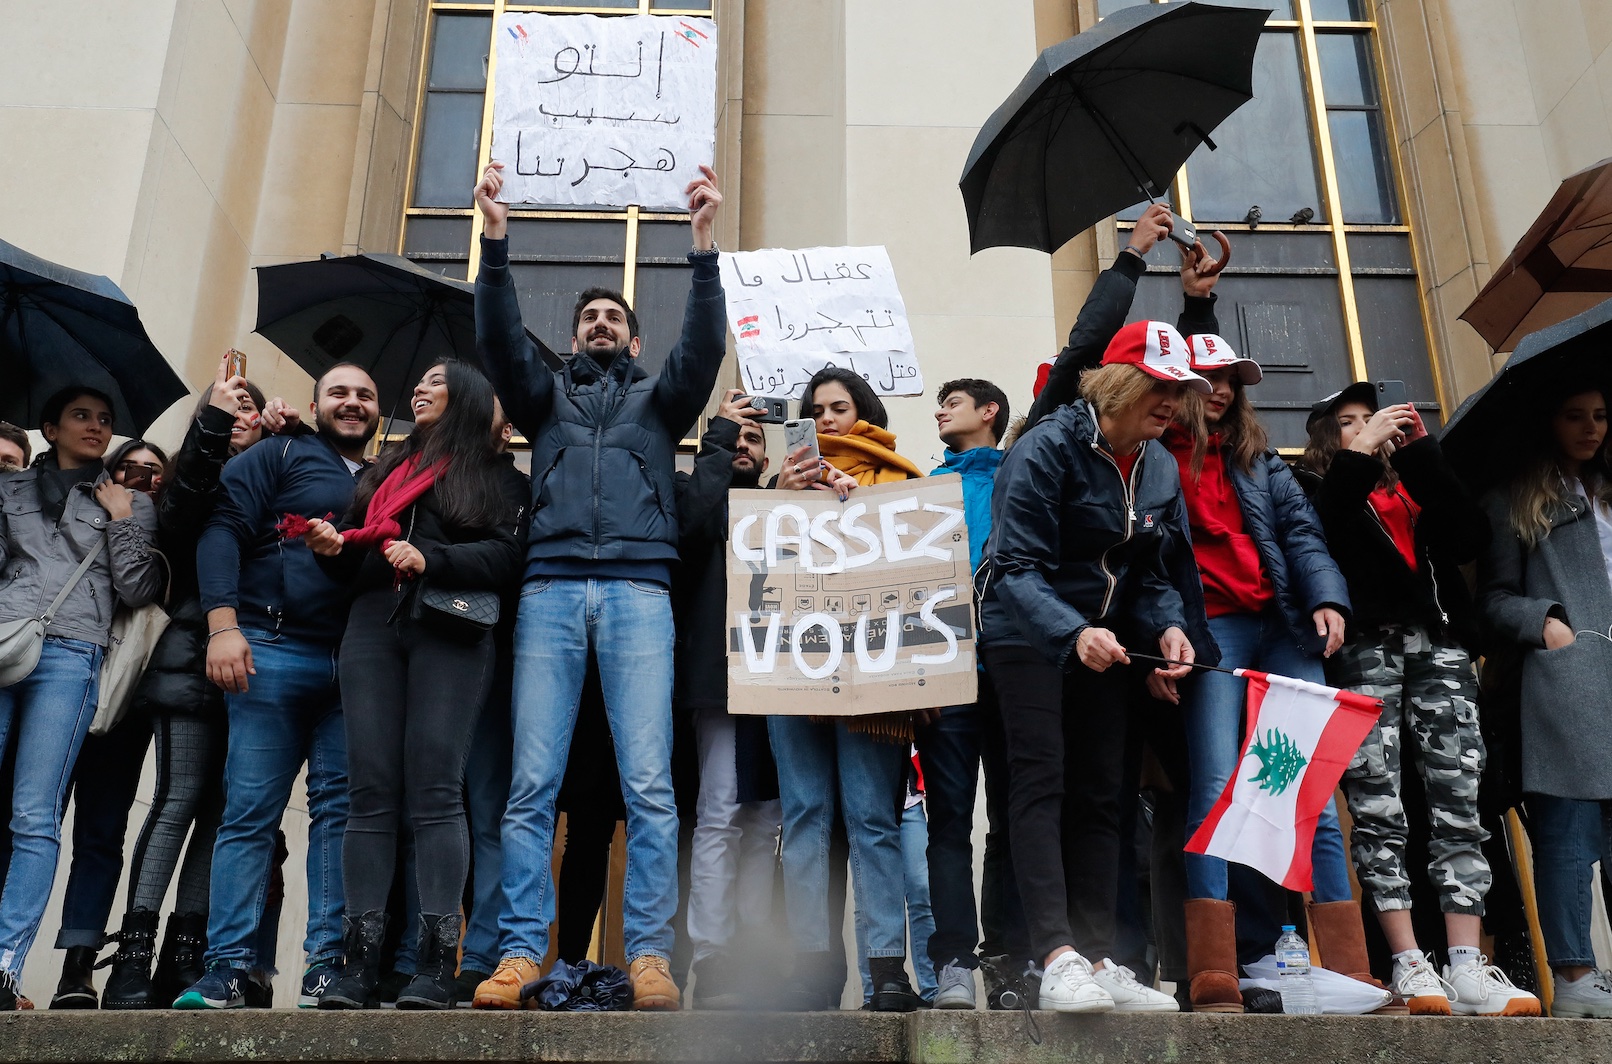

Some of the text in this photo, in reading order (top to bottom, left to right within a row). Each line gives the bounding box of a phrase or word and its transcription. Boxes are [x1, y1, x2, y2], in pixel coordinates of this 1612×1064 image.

[538, 103, 681, 125] سبب
[516, 130, 676, 187] هجرتنا
[732, 253, 872, 287] عقبال ما
[775, 304, 895, 347] تتهجروا
[879, 356, 917, 392] متل
[732, 496, 966, 574] CASSEZ
[740, 588, 959, 679] VOUS
